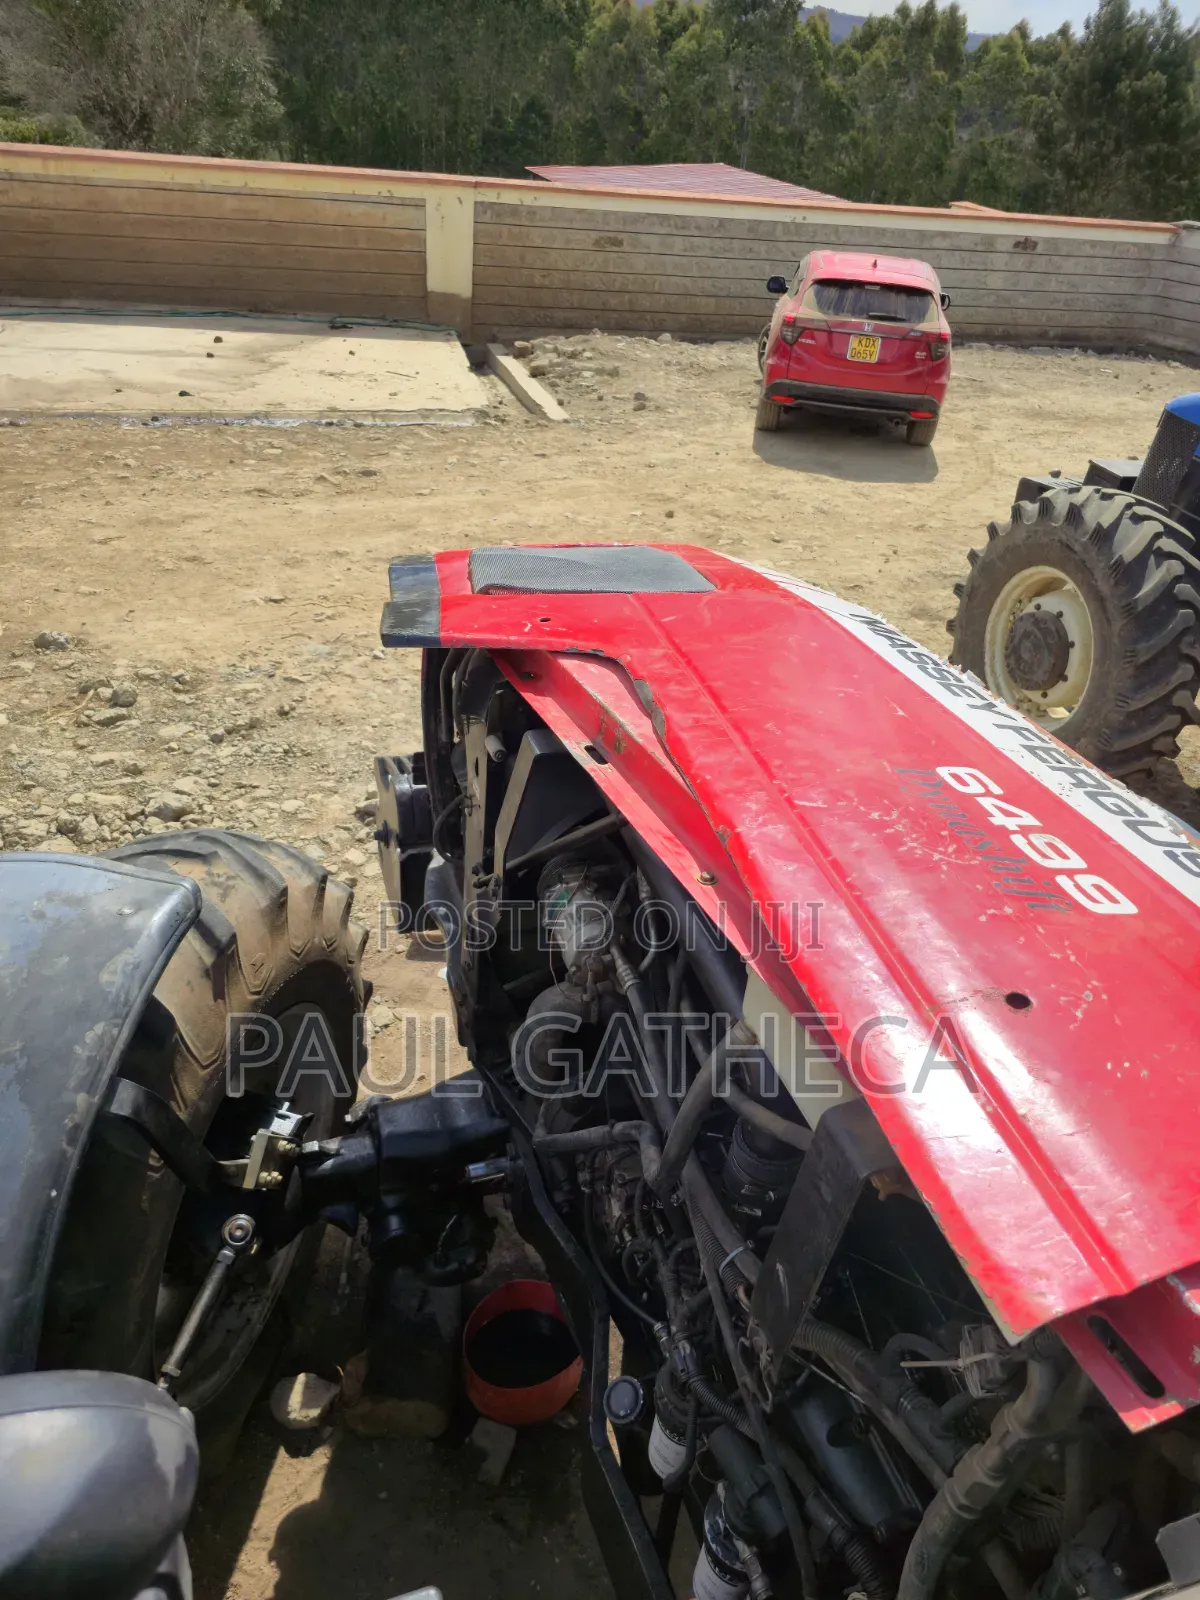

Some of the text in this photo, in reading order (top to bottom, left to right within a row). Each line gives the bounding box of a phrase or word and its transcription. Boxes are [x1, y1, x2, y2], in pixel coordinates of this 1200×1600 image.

[857, 336, 877, 349] KDX
[848, 612, 1017, 722] MASSEY
[893, 767, 1075, 914] Dynashift
[936, 766, 1139, 914] 6499
